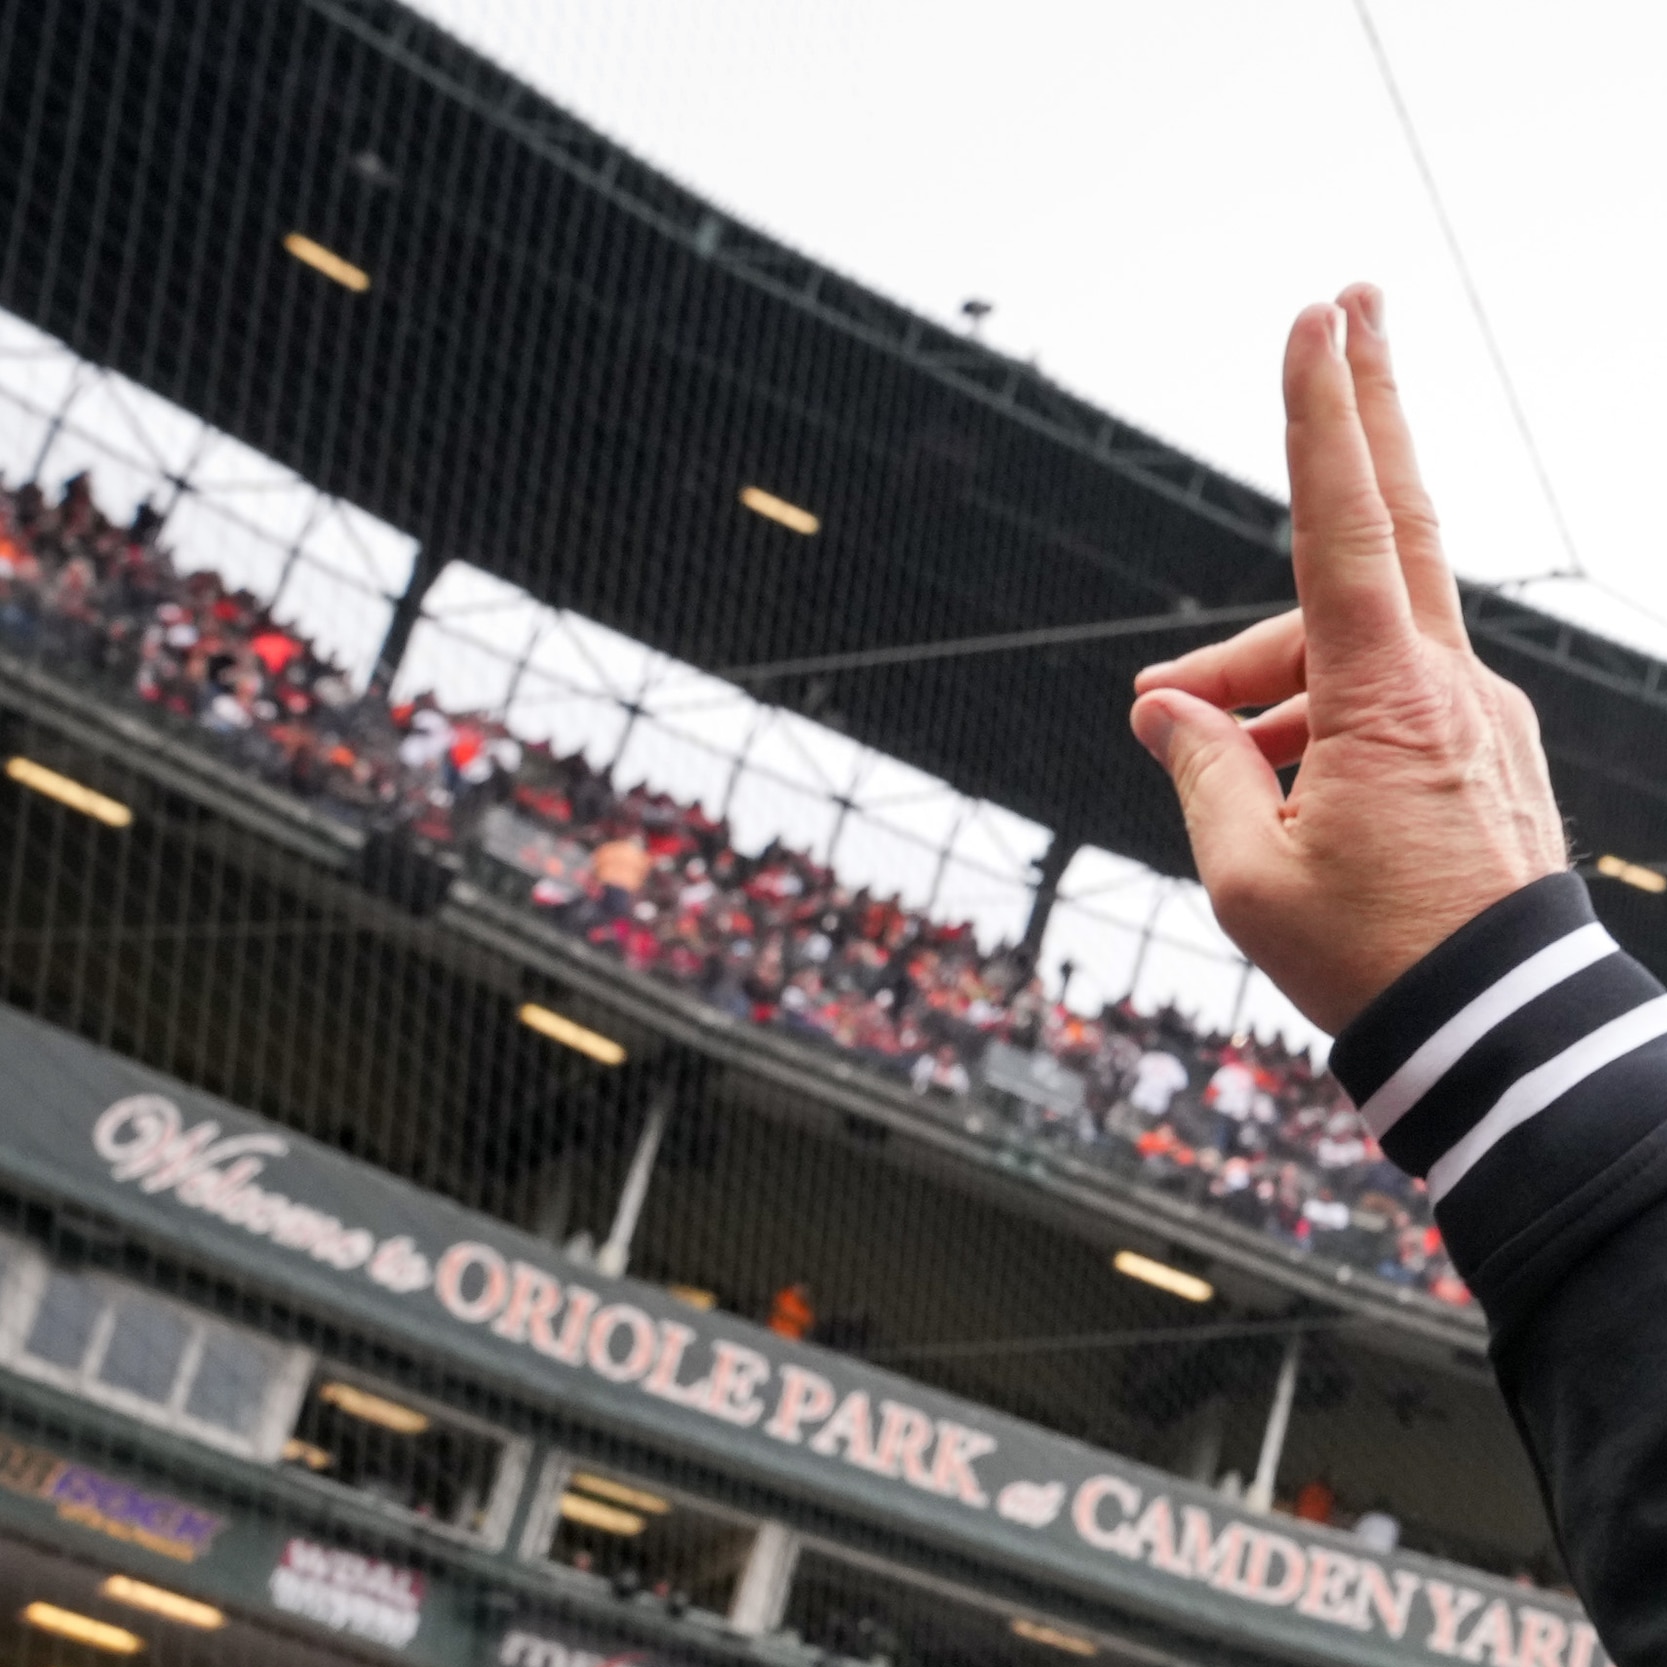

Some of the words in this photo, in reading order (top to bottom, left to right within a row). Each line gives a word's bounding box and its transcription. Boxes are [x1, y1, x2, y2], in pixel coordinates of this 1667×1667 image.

[94, 1093, 375, 1271] Welcome
[434, 1241, 770, 1428] ORIOLE
[764, 1364, 998, 1510] PARK
[1072, 1474, 1421, 1641] CAMDEN
